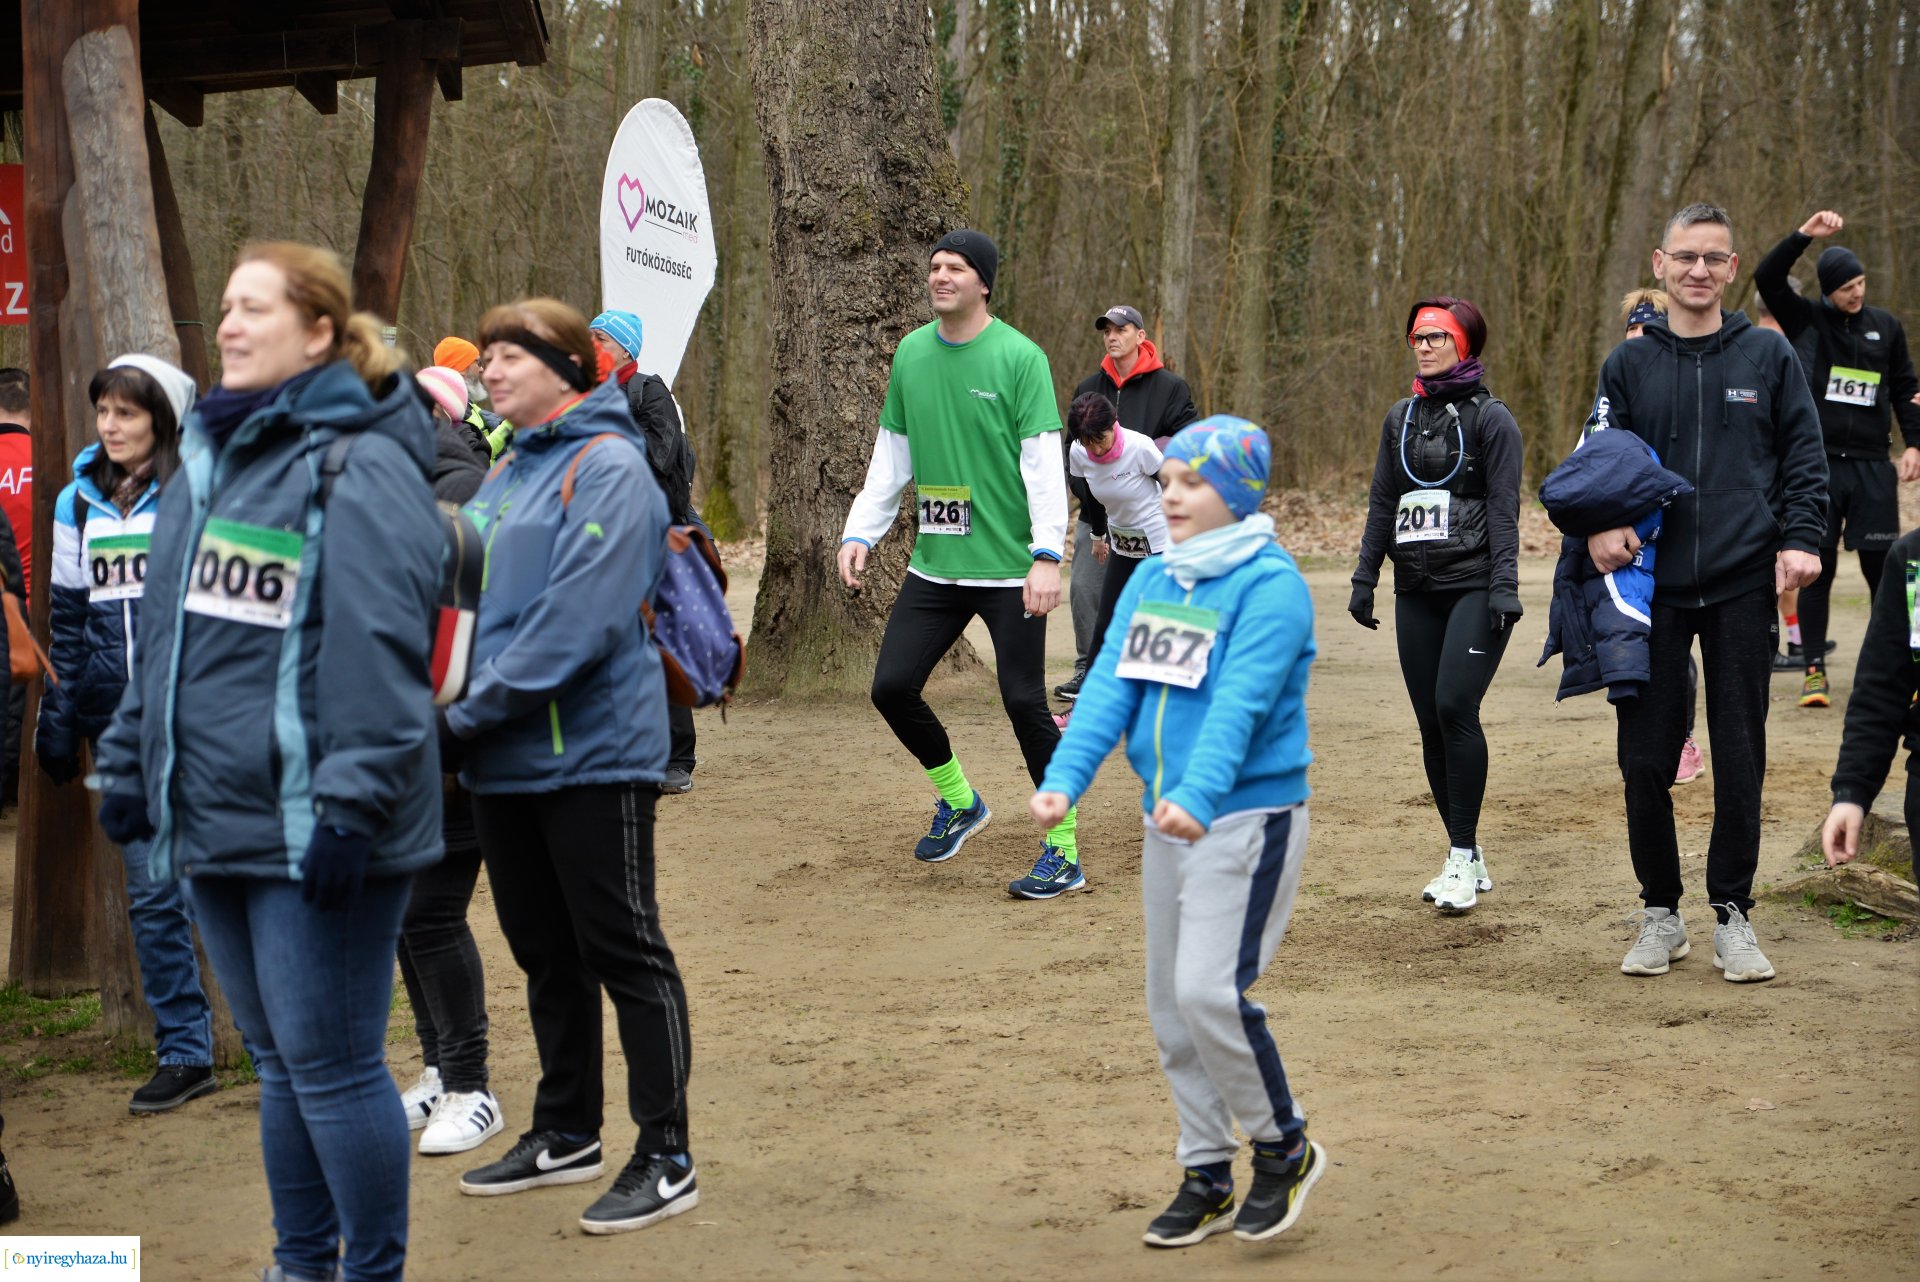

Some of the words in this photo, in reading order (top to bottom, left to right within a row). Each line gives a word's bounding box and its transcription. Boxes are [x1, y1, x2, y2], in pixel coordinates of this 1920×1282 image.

[645, 195, 698, 233] MOZAIK
[626, 246, 692, 280] FUTÓKÖZÖSSÉG
[0, 282, 29, 315] Z
[1832, 378, 1867, 397] 161
[921, 500, 960, 524] 126
[1399, 504, 1441, 531] 201
[92, 552, 148, 587] 010
[200, 550, 284, 601] 006
[1129, 623, 1206, 666] 067
